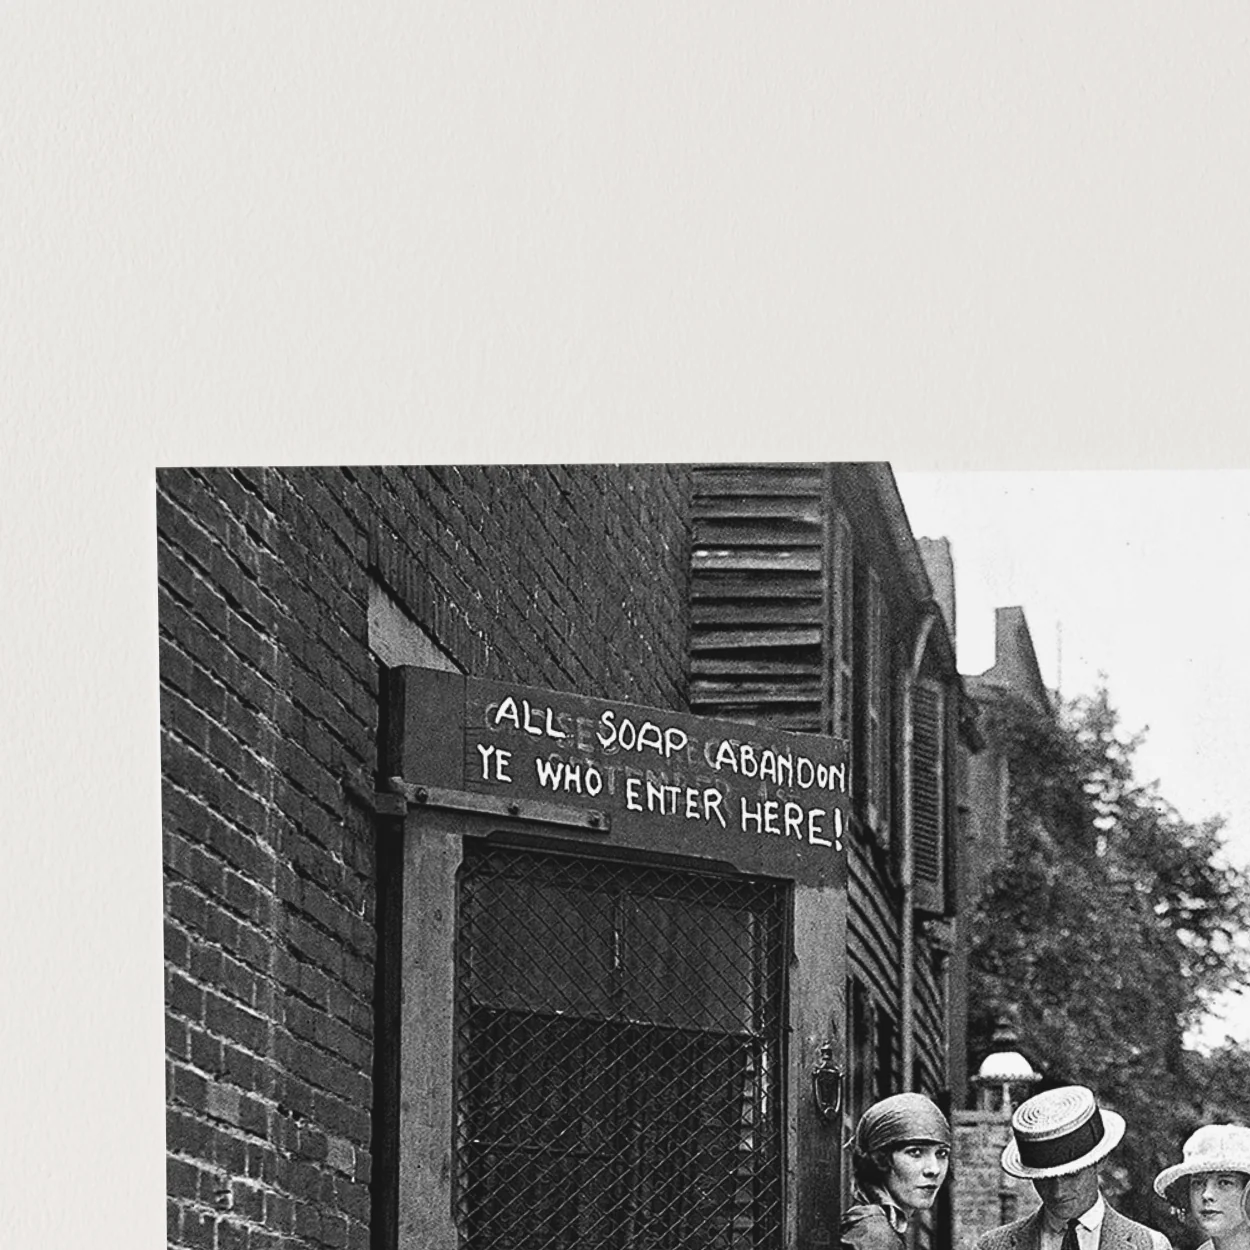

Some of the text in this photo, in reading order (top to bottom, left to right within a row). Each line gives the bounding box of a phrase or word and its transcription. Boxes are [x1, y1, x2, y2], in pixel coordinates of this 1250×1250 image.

[495, 696, 566, 738] ALL
[596, 710, 688, 758] SOAP
[715, 740, 846, 793] ABANDON
[477, 743, 512, 782] YE
[536, 757, 602, 796] WHO
[626, 777, 727, 829] ENTER
[740, 796, 843, 851] HERE!
